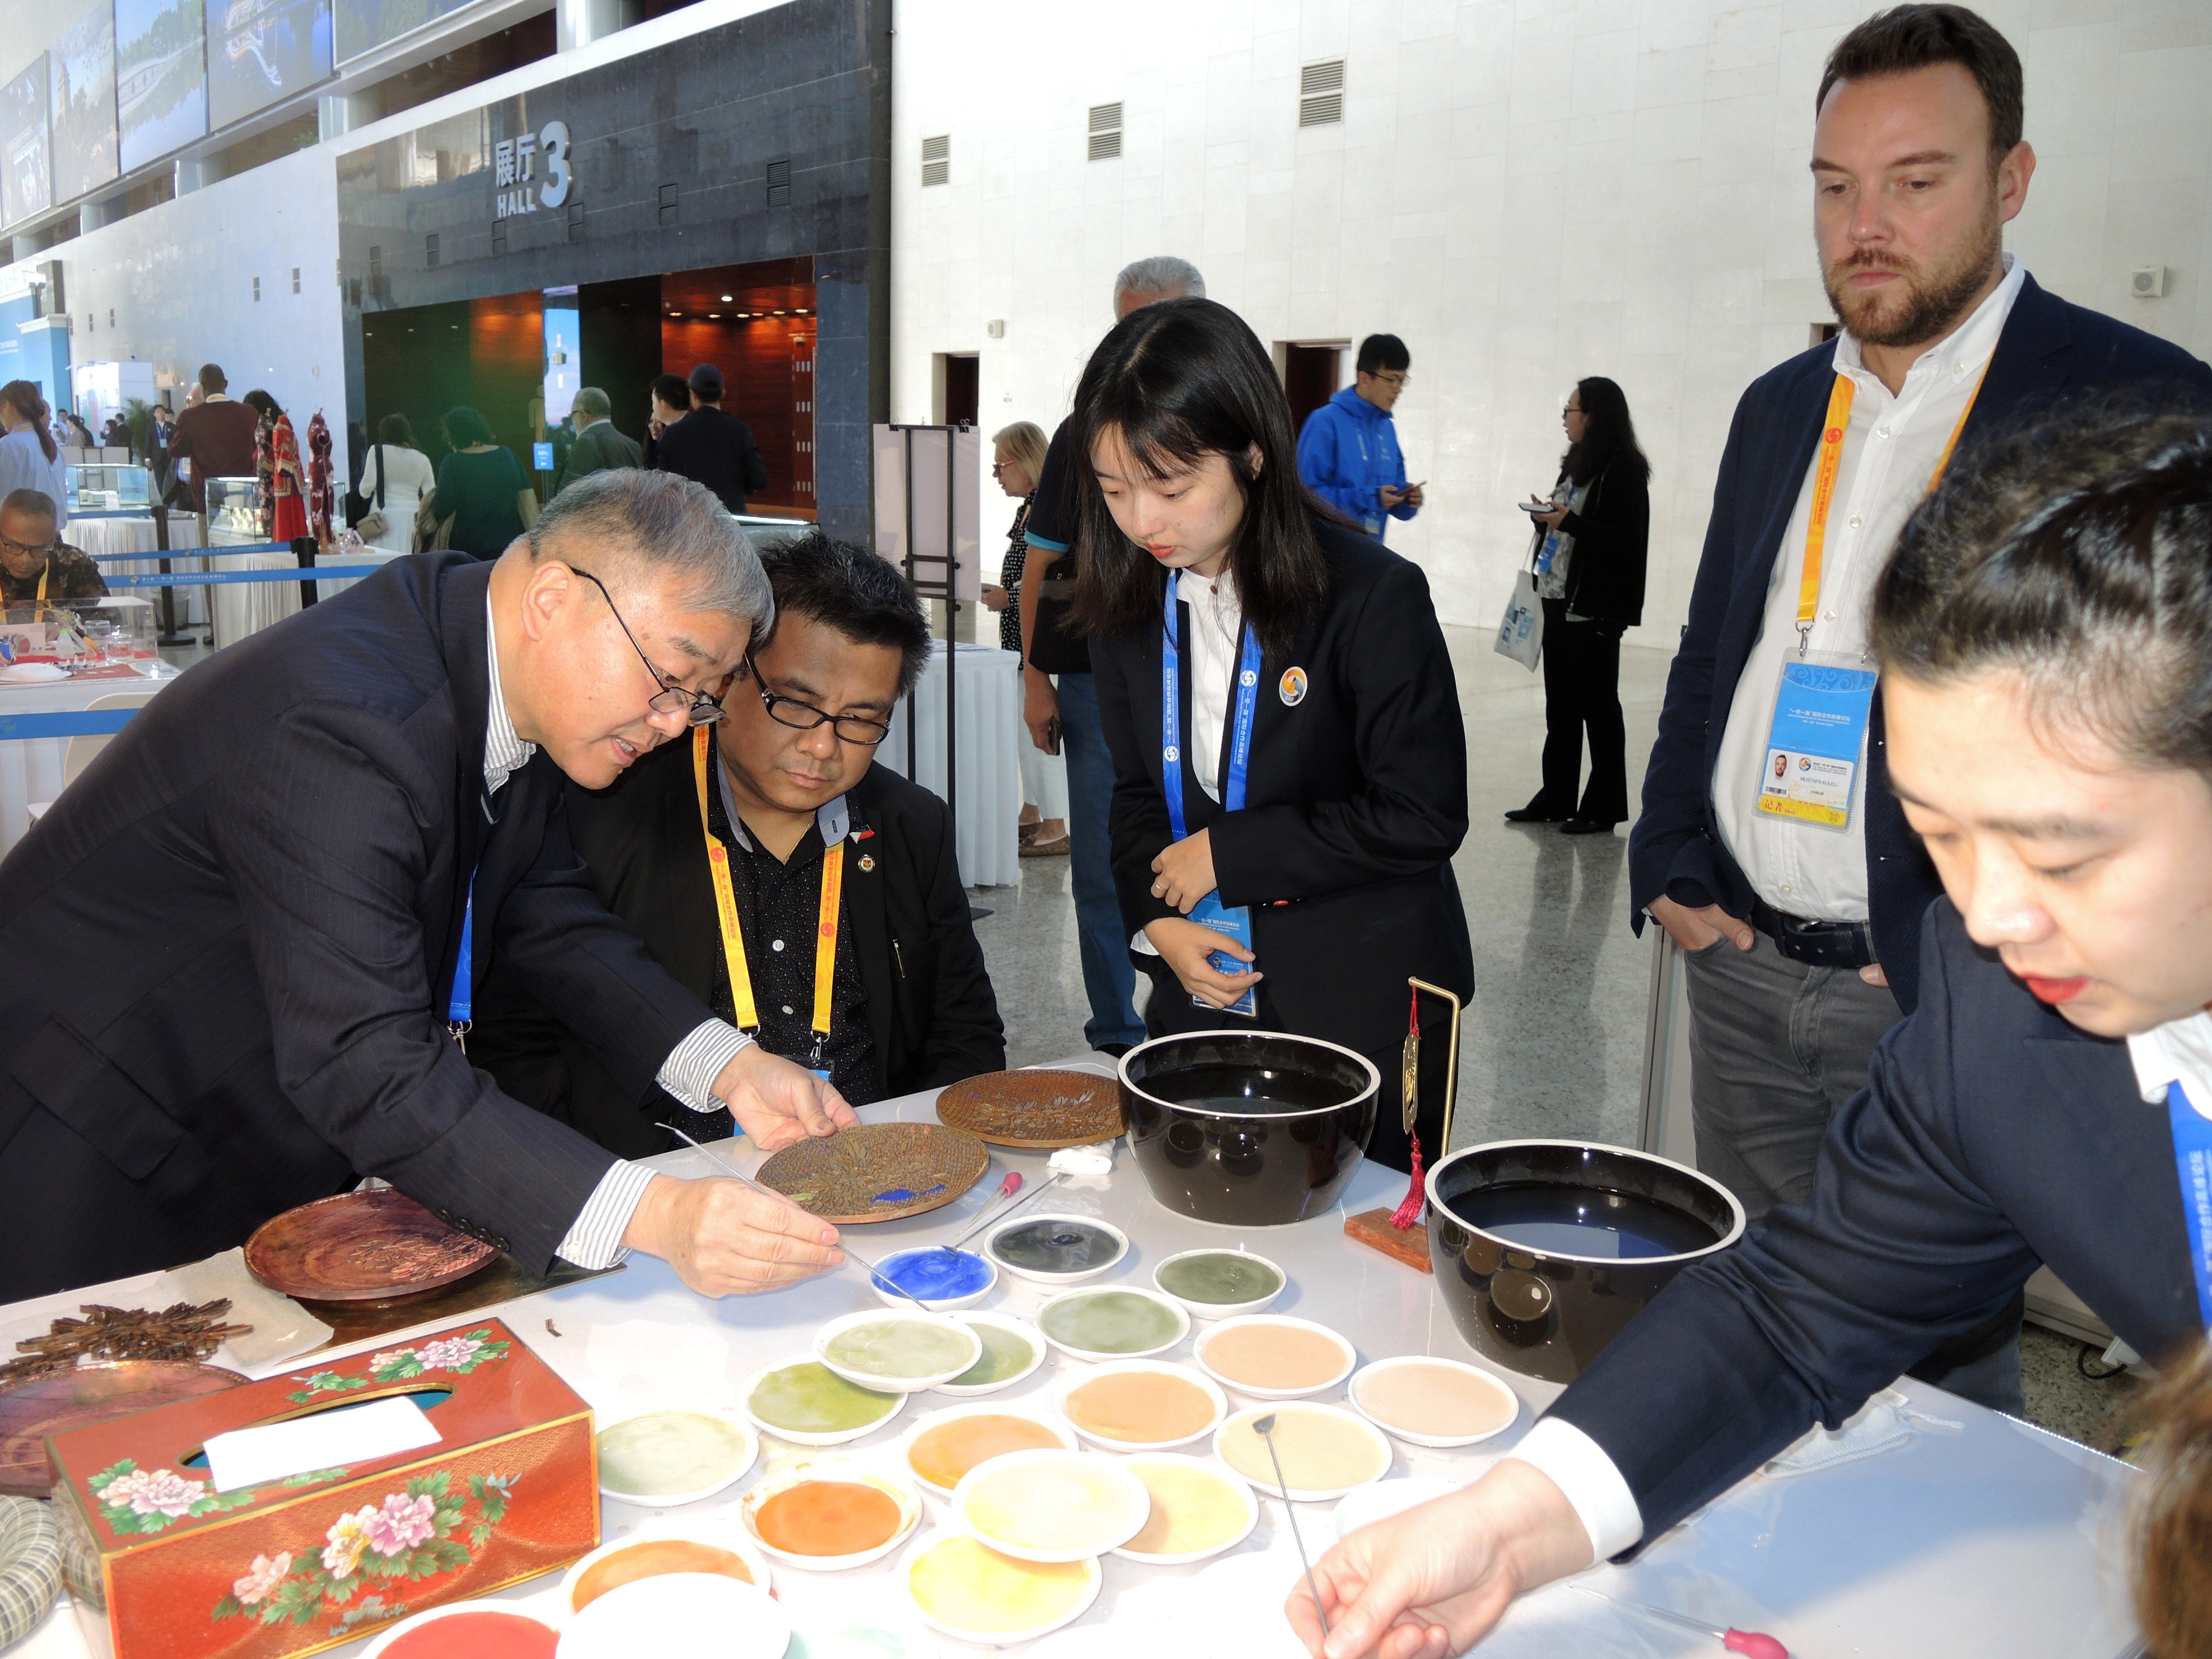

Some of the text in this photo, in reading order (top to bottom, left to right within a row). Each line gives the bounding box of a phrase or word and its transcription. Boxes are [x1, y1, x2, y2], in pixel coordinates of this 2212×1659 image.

[496, 120, 570, 208] 展厅 3
[497, 188, 537, 218] HALL
